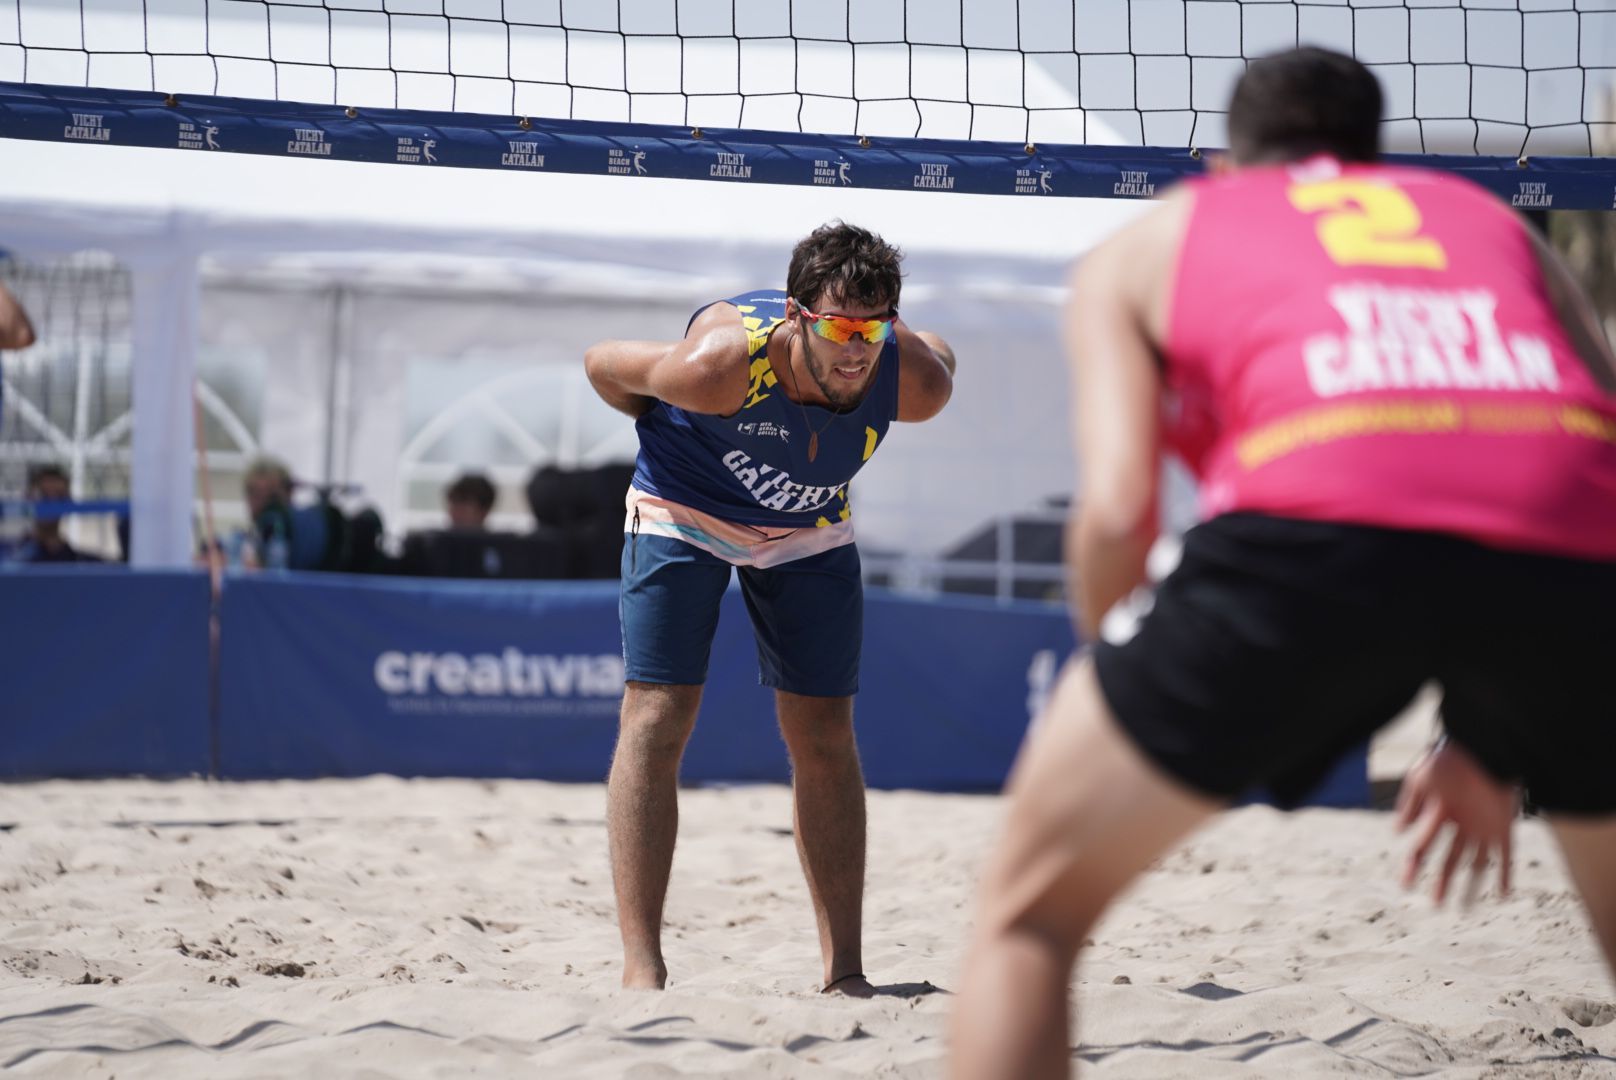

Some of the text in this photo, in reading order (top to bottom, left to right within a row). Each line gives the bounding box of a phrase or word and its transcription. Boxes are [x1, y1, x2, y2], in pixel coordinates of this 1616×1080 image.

[72, 114, 103, 128] VICHY
[179, 123, 195, 131] MED
[64, 126, 111, 141] CATALAN
[179, 131, 202, 140] BEACH
[295, 129, 325, 142] VICHY
[178, 140, 203, 149] VOLLEY
[287, 141, 332, 155] CATALAN
[397, 145, 419, 154] BEACH
[509, 141, 538, 154] VICHY
[397, 154, 420, 162] VOLLEY
[609, 149, 623, 157] MED
[717, 152, 745, 166] VICHY
[502, 153, 544, 167] CATALAN
[609, 157, 630, 165] BEACH
[815, 160, 828, 168] MED
[608, 166, 631, 174] VOLLEY
[710, 164, 752, 178] CATALAN
[814, 168, 835, 176] BEACH
[921, 163, 948, 176] VICHY
[813, 176, 836, 185] VOLLEY
[914, 175, 954, 189] CATALAN
[1016, 177, 1036, 185] BEACH
[1121, 171, 1148, 183] VICHY
[1114, 183, 1154, 196] CATALAN
[1520, 182, 1546, 194] VICHY
[1512, 194, 1553, 206] CATALAN
[1286, 178, 1448, 269] 2
[1330, 283, 1497, 341] VICHY
[1304, 333, 1560, 397] CATALAN
[722, 450, 829, 513] CATA
